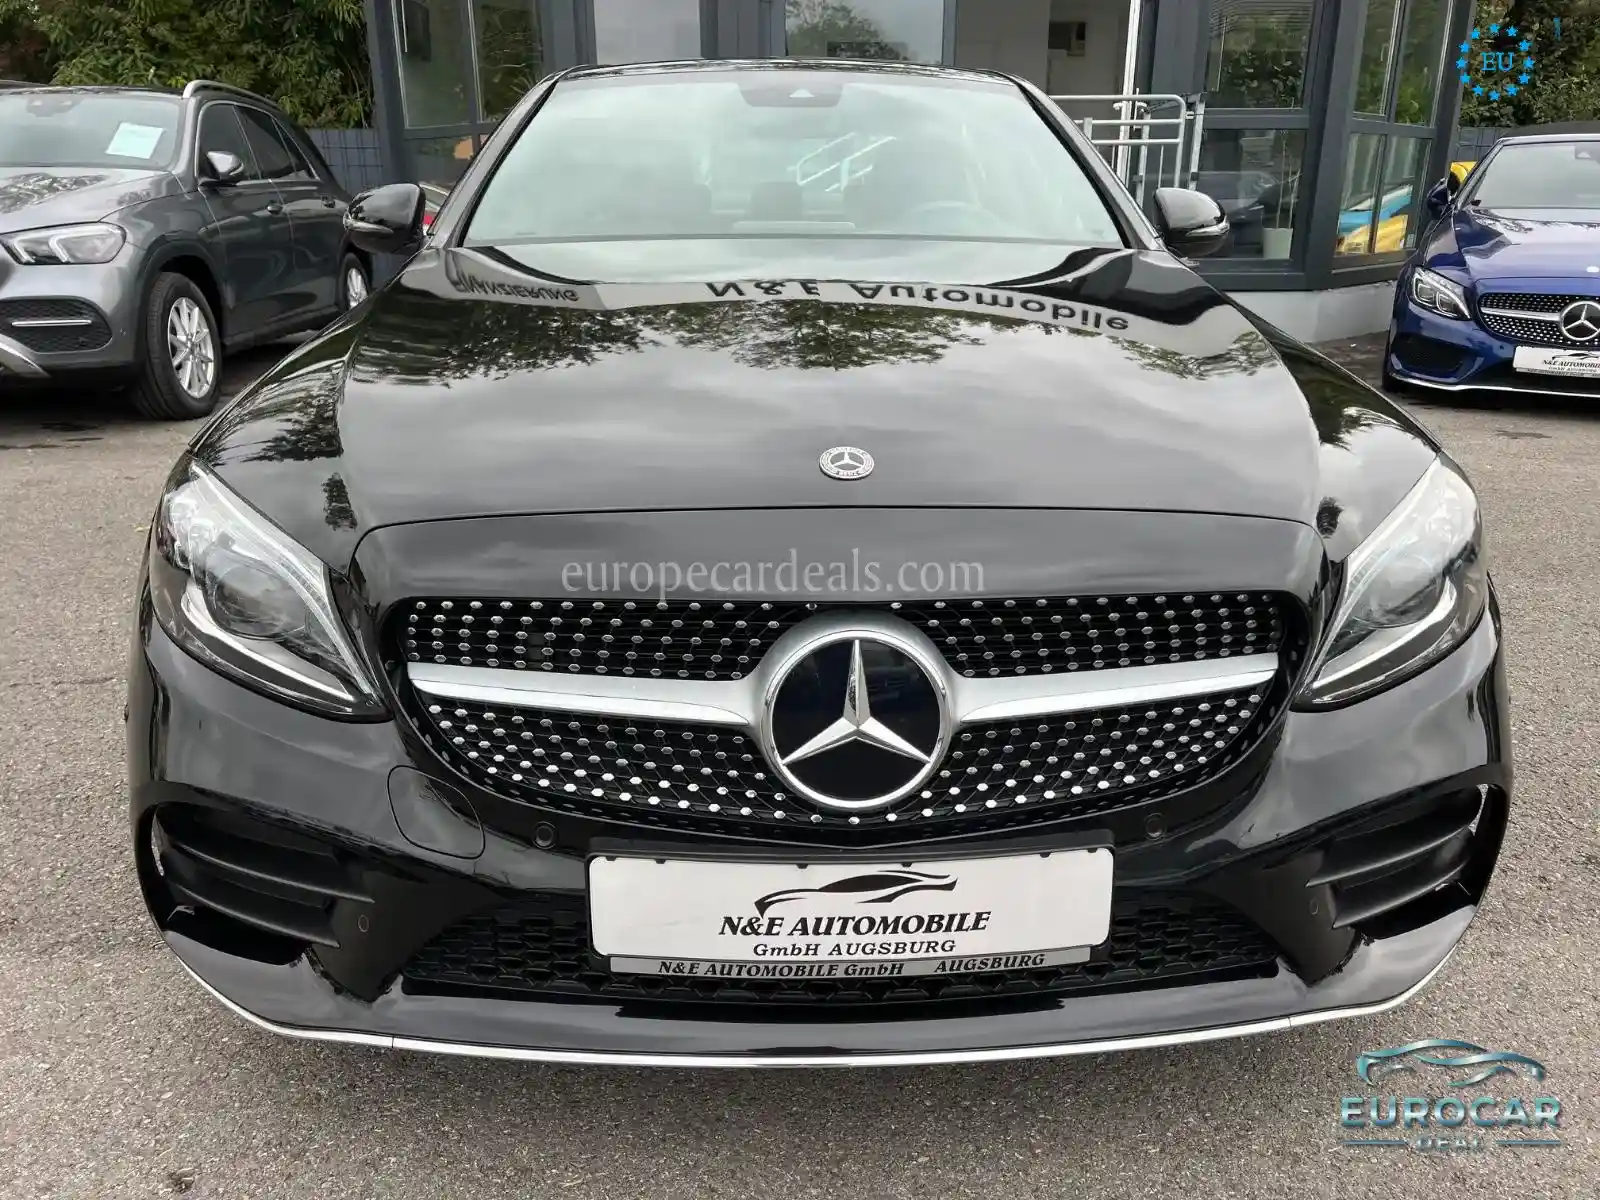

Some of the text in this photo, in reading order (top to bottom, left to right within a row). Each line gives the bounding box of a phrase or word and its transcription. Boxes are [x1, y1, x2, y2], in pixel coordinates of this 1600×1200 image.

[719, 911, 992, 936] N&E AUTOMOBILE
[753, 939, 956, 957] GmbH AUGSBURG
[658, 953, 1046, 977] N&E AUTOMOBILE GmbH AUGSBURG
